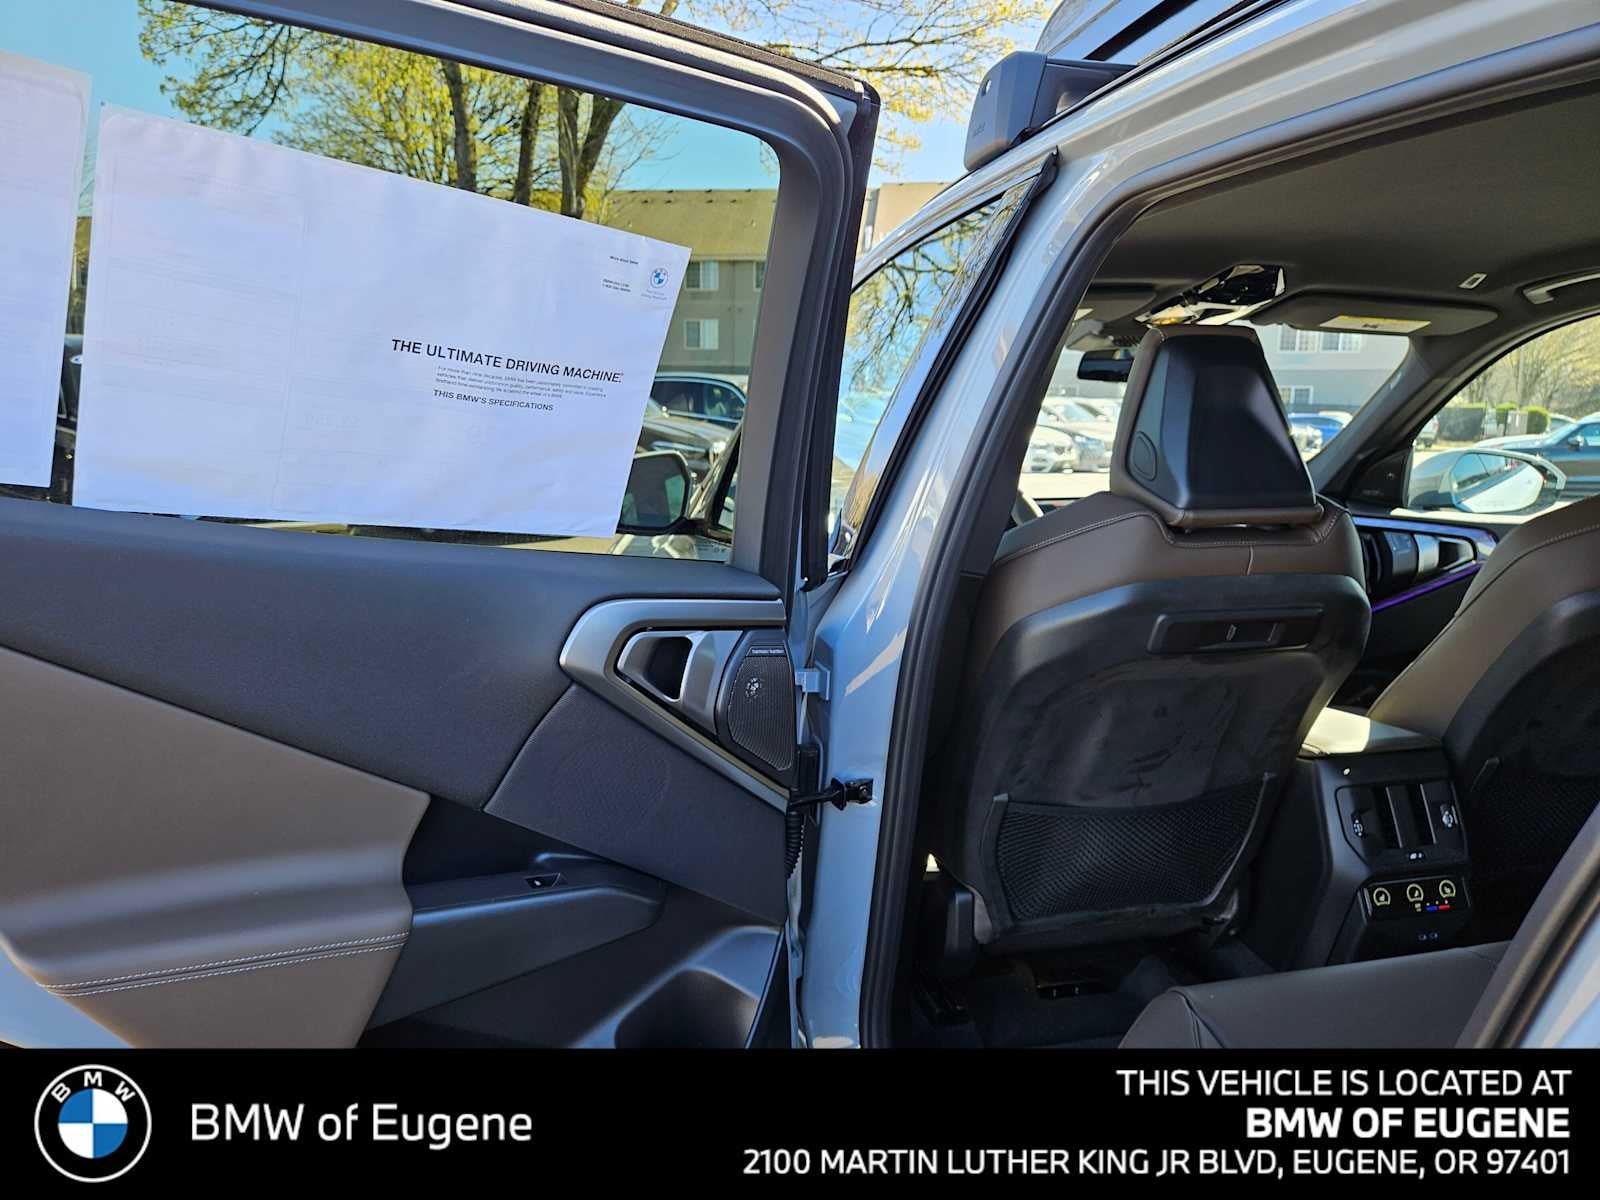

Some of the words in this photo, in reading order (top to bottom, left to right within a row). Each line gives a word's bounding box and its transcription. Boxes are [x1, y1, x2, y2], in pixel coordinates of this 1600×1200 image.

[391, 338, 422, 354] THE
[426, 343, 503, 368] ULTIMATE
[505, 357, 560, 376] DRIVING
[432, 389, 455, 400] THIS
[456, 393, 487, 405] BMW'S
[488, 397, 555, 411] SPECIFICATIONS
